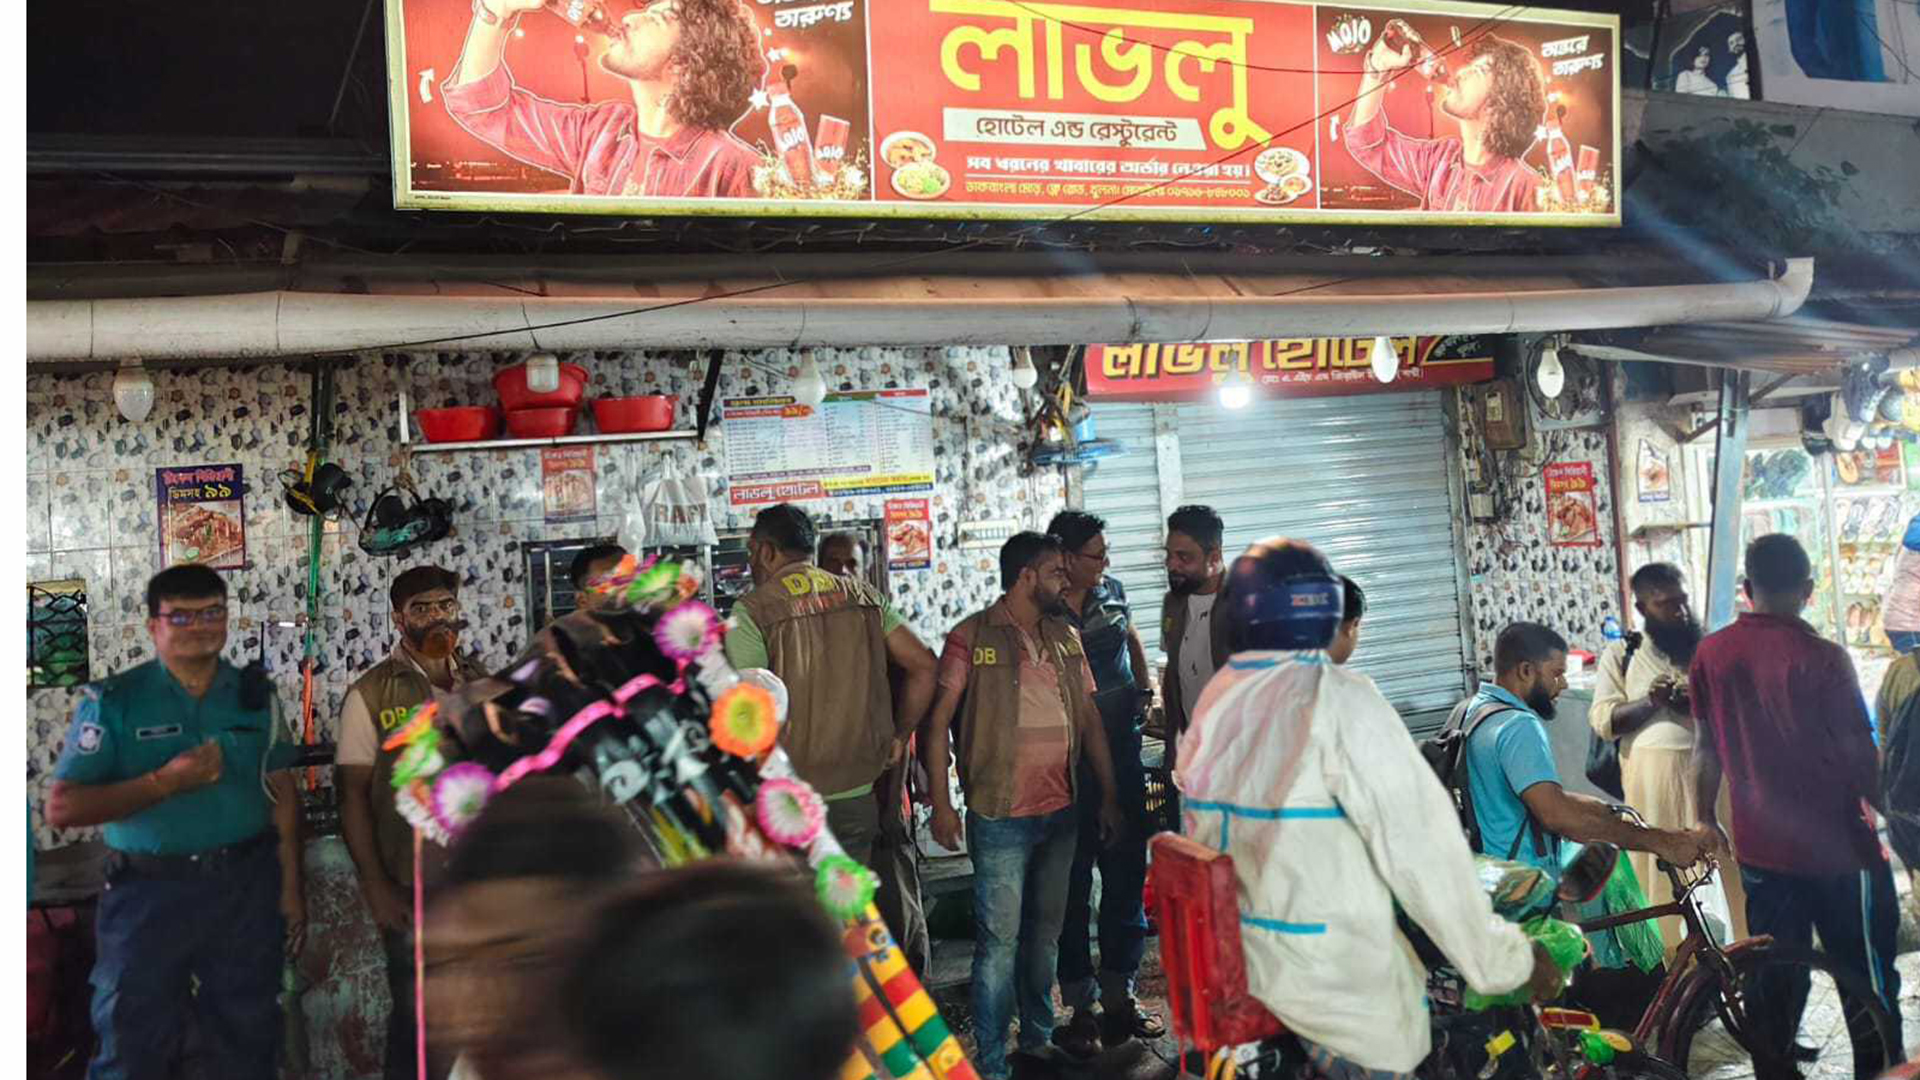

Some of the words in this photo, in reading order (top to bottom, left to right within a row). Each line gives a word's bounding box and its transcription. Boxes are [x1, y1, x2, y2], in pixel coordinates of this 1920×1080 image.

[775, 1, 854, 28] তারুণ্য
[1326, 18, 1371, 52] MOJO
[929, 0, 1271, 149] লাভলু
[976, 115, 1044, 137] হোটেল
[1051, 119, 1084, 138] এন্ড
[1090, 120, 1177, 147] রেস্টুরেন্ট
[967, 157, 991, 170] সব
[1053, 158, 1117, 175] খাবারের
[1120, 157, 1169, 177] অর্ডার
[203, 483, 232, 498] ৯৯
[973, 646, 996, 665] DB
